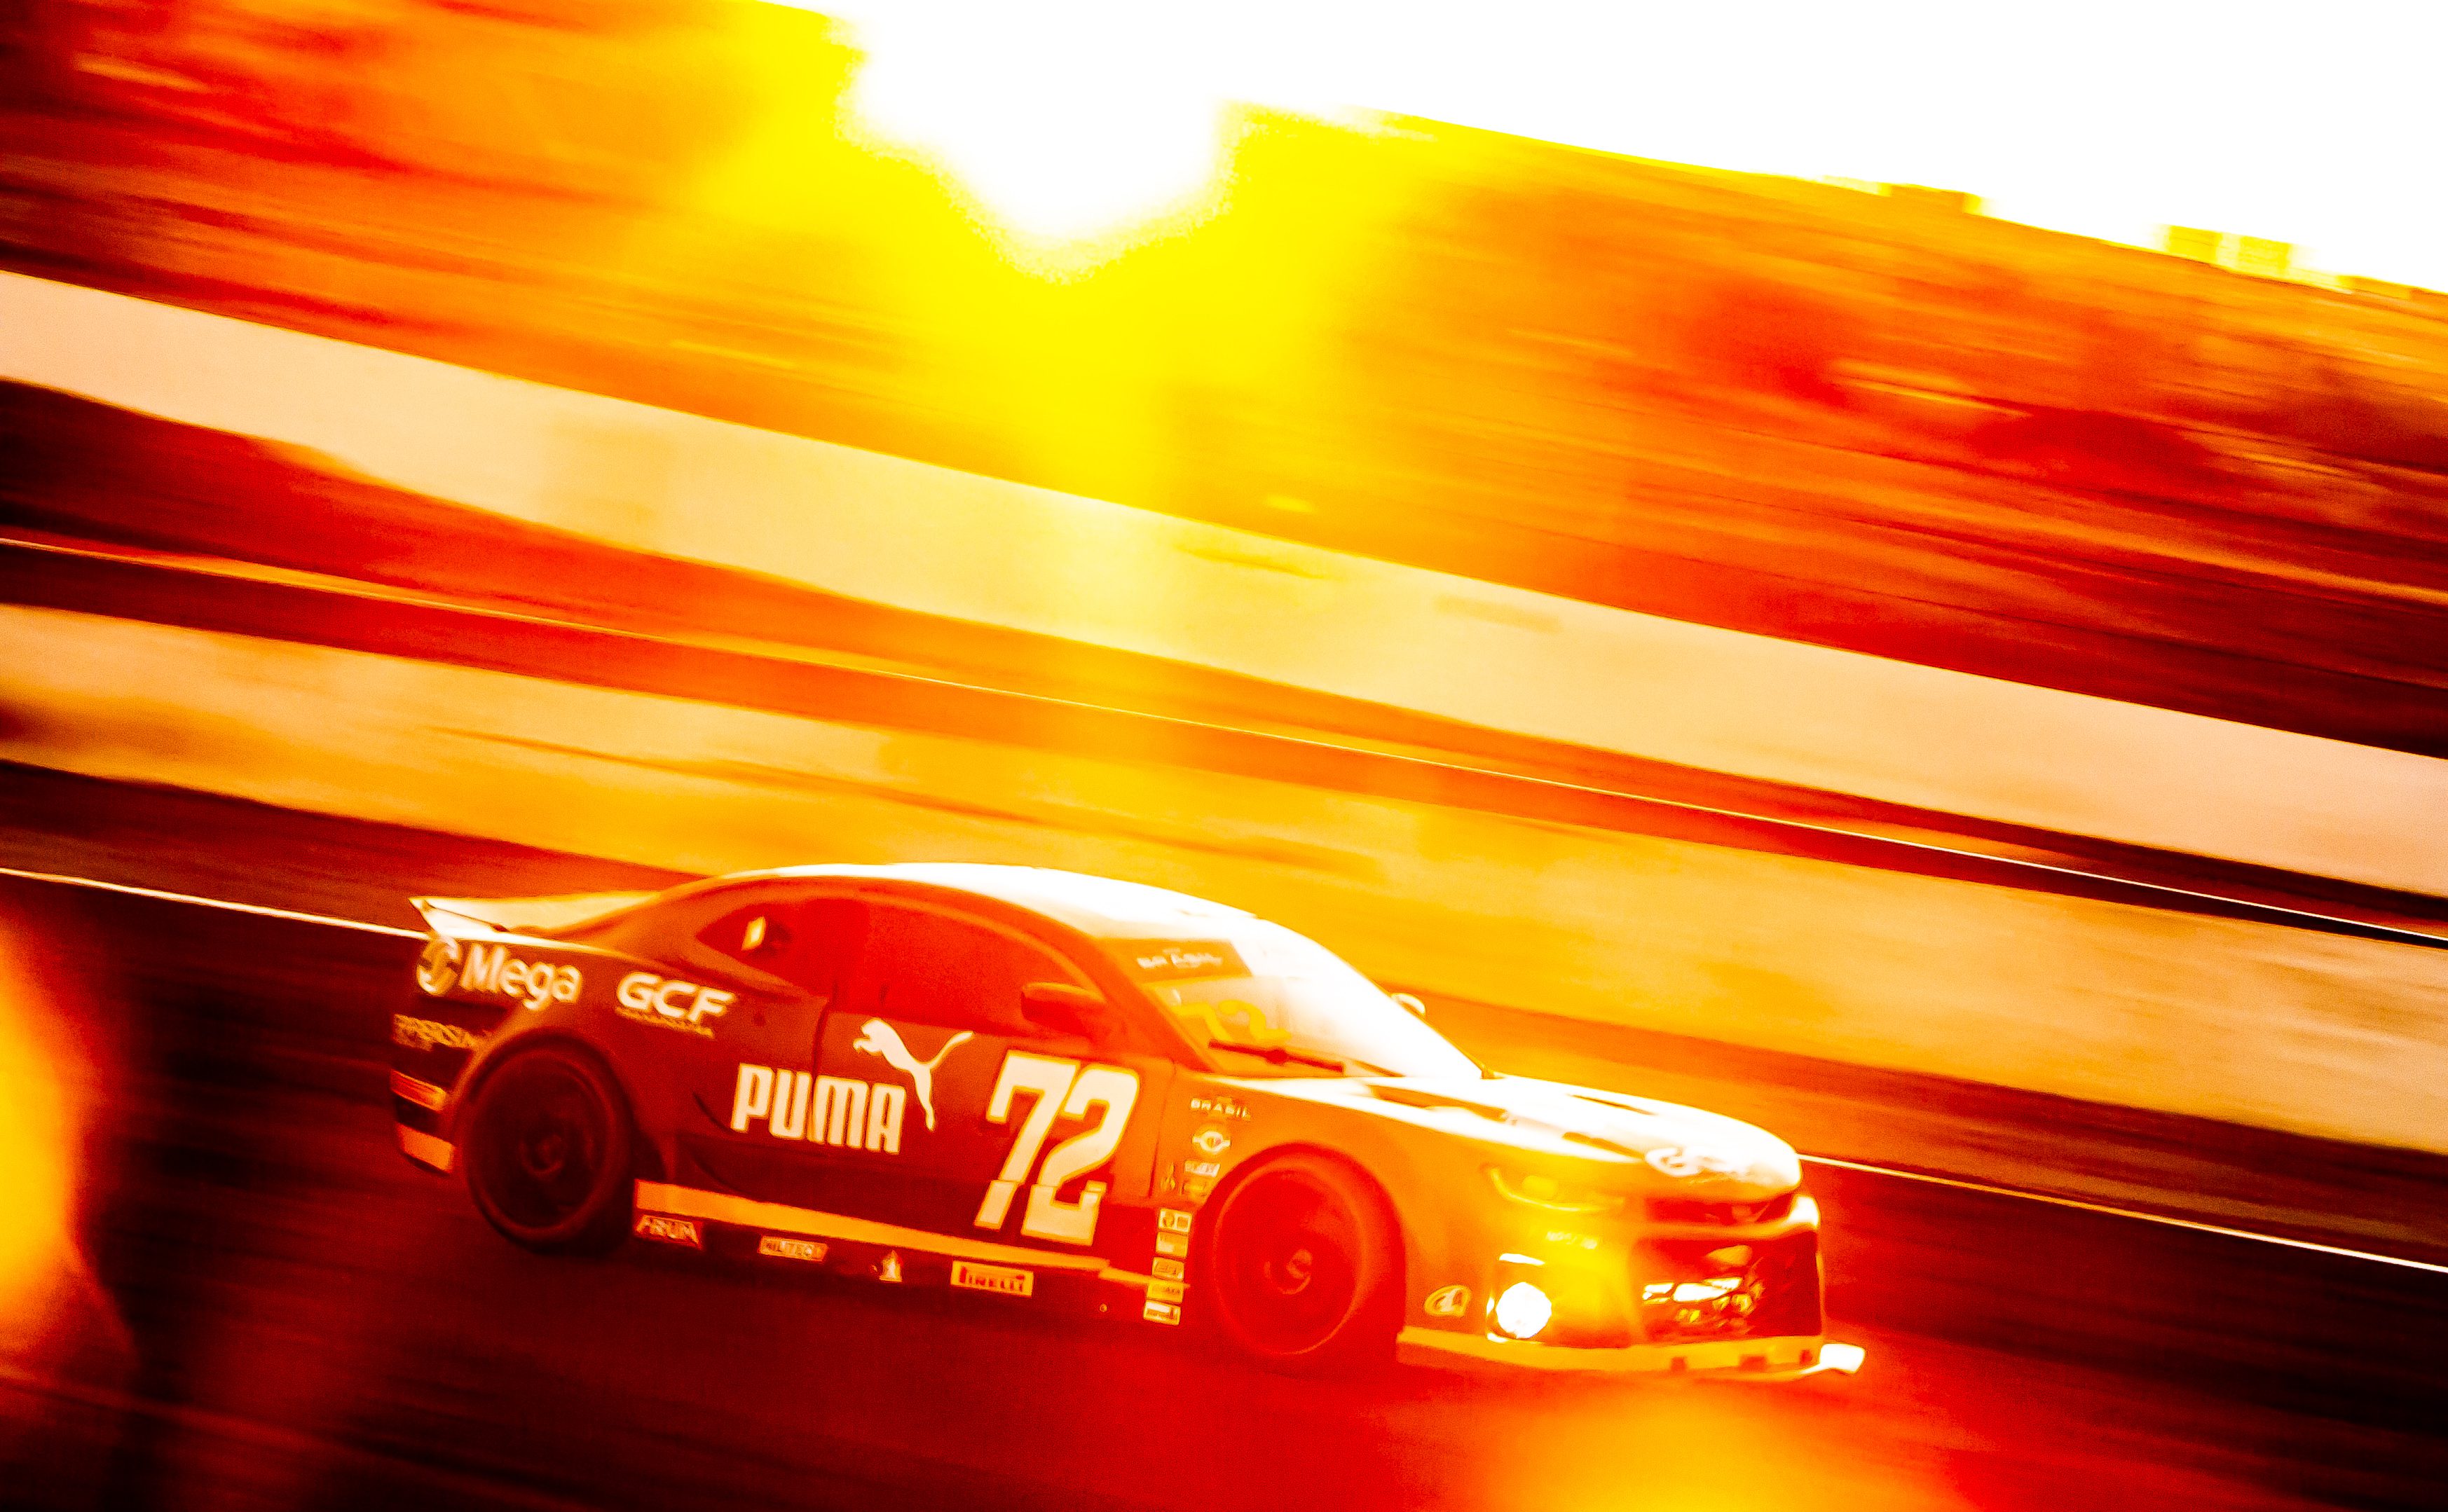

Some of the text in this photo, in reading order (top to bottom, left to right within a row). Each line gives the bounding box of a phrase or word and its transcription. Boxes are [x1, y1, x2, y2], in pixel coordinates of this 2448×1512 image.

[460, 943, 583, 1011] Mega
[616, 971, 736, 1024] GCF
[730, 1062, 907, 1155] PUMA
[974, 1050, 1140, 1246] 72
